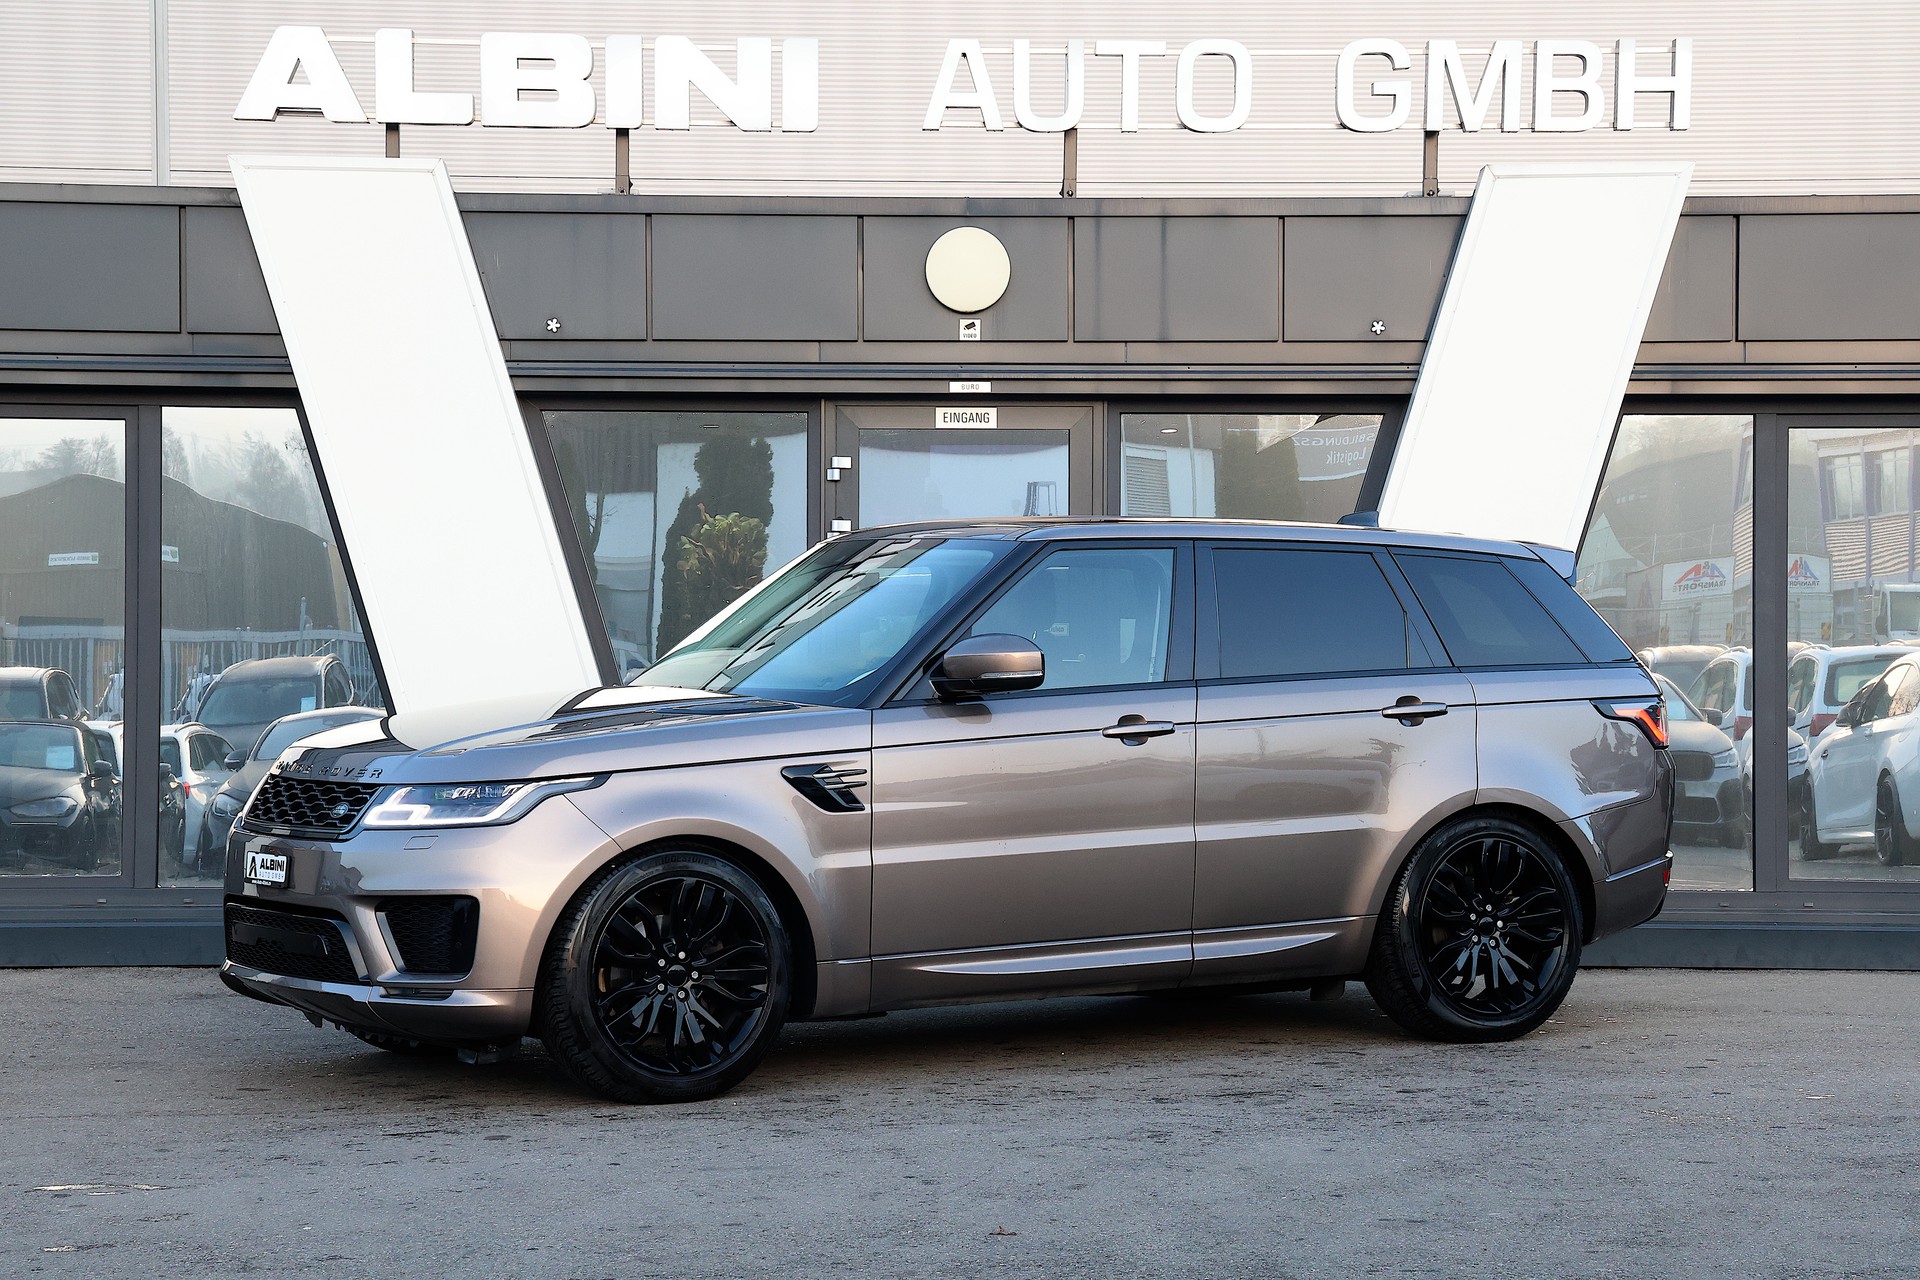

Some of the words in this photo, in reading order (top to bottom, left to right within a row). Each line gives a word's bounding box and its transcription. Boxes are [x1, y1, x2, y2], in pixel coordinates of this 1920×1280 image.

[233, 25, 819, 133] ALBINI
[922, 38, 1253, 133] AUTO
[1335, 37, 1694, 133] GMBH
[943, 412, 990, 423] EINGANG
[319, 767, 384, 779] ROVER
[260, 858, 285, 872] ALBINI
